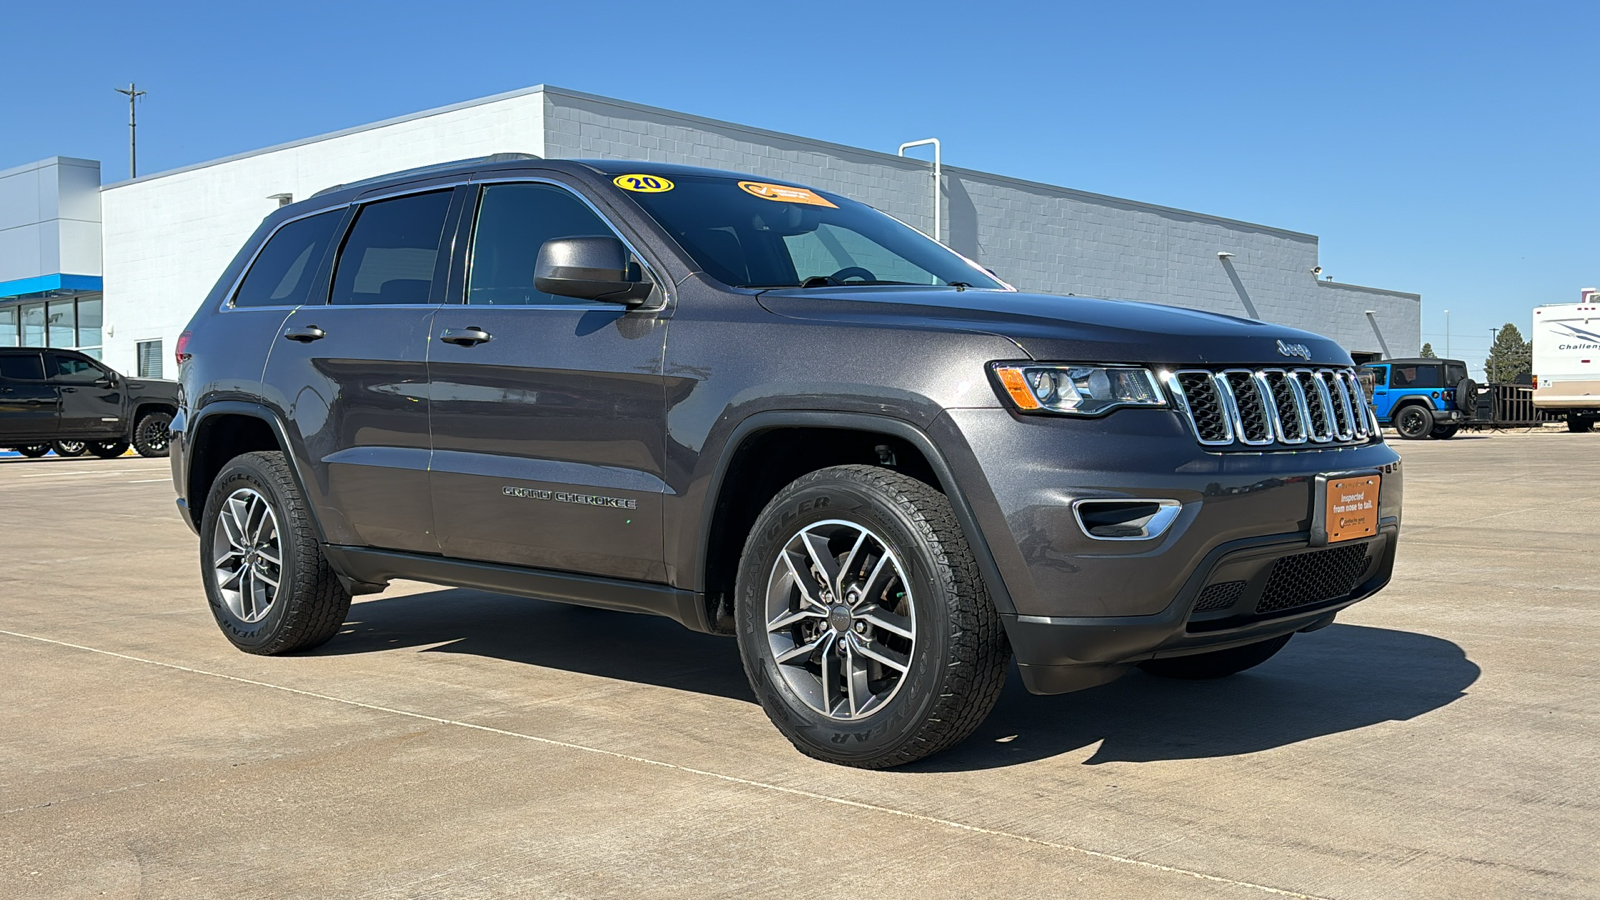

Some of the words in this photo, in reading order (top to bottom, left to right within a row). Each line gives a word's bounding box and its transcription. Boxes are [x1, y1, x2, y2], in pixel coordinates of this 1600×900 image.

[627, 177, 661, 190] 20
[1276, 339, 1312, 361] Jeep
[502, 486, 552, 500] GRAND
[555, 491, 637, 510] CHEROKEE
[1341, 491, 1365, 503] Inspected
[1333, 504, 1345, 514] from
[1346, 504, 1357, 512] nose
[1357, 502, 1363, 510] to
